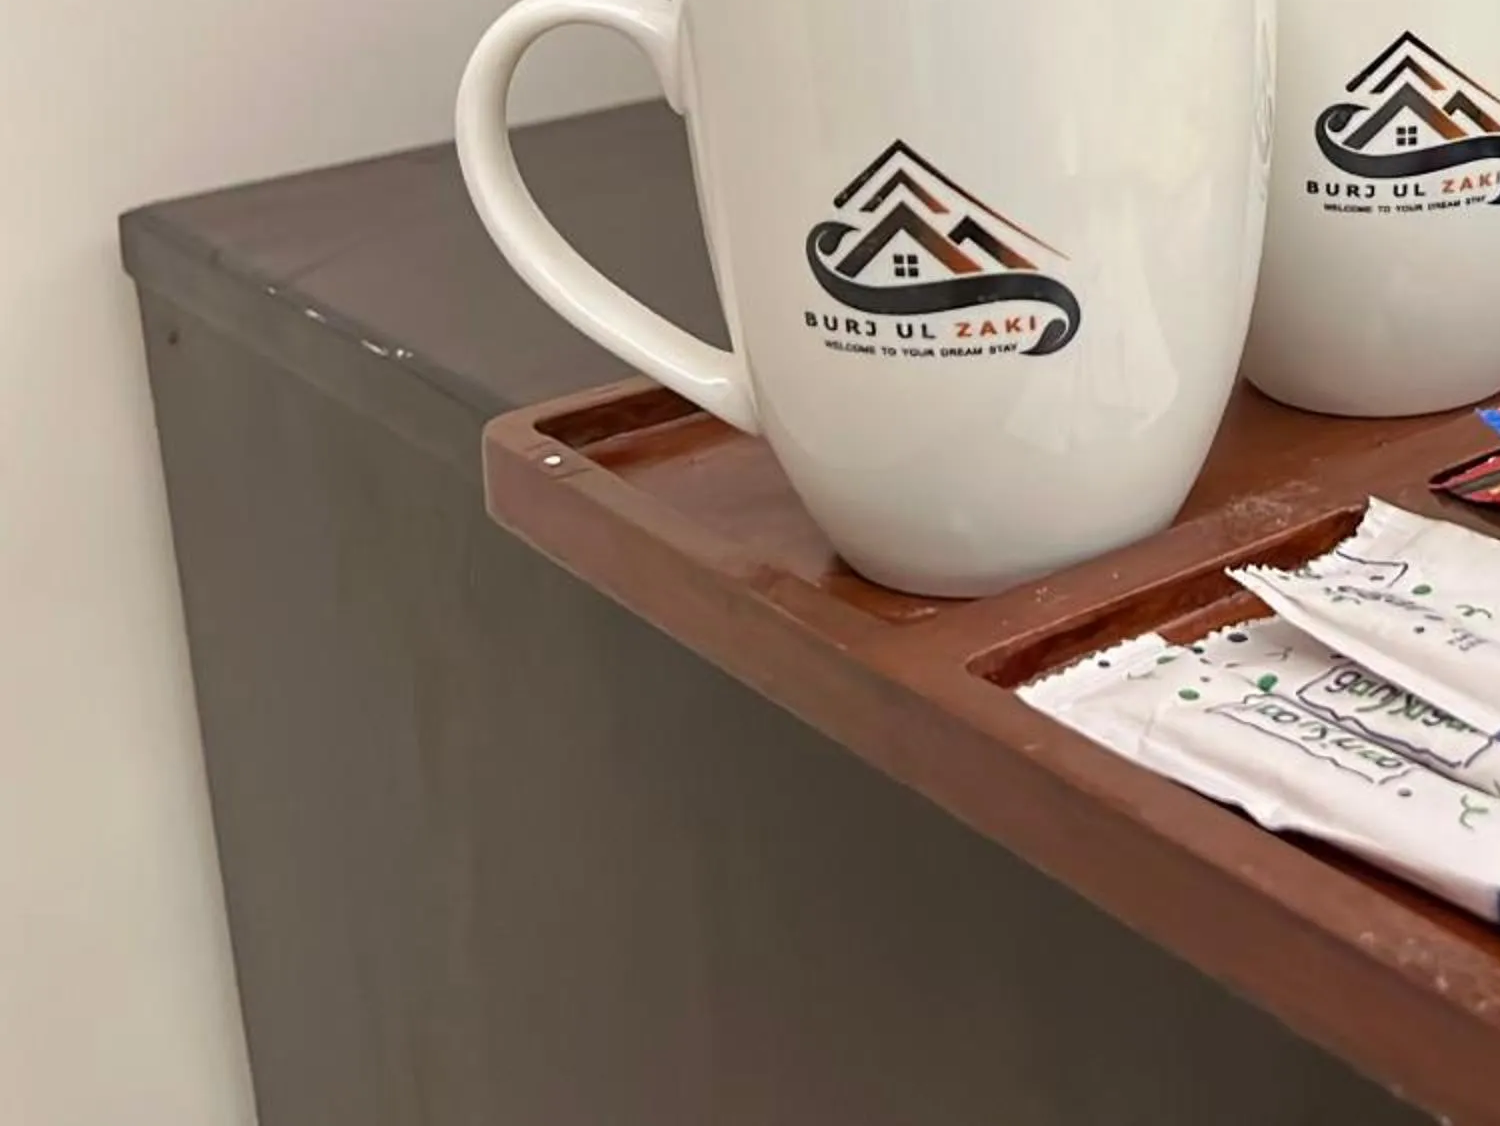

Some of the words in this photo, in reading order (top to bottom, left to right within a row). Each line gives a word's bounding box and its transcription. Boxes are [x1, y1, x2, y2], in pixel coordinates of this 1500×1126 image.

[1306, 179, 1376, 199] BURJ
[1393, 184, 1426, 197] UL
[804, 311, 877, 337] BURJ
[896, 322, 937, 339] UL
[954, 315, 1036, 338] ZAKI
[824, 340, 876, 355] WELCOME
[881, 346, 897, 357] TO
[902, 348, 935, 358] YOUR
[940, 347, 983, 358] DREAM
[989, 342, 1017, 355] STAY
